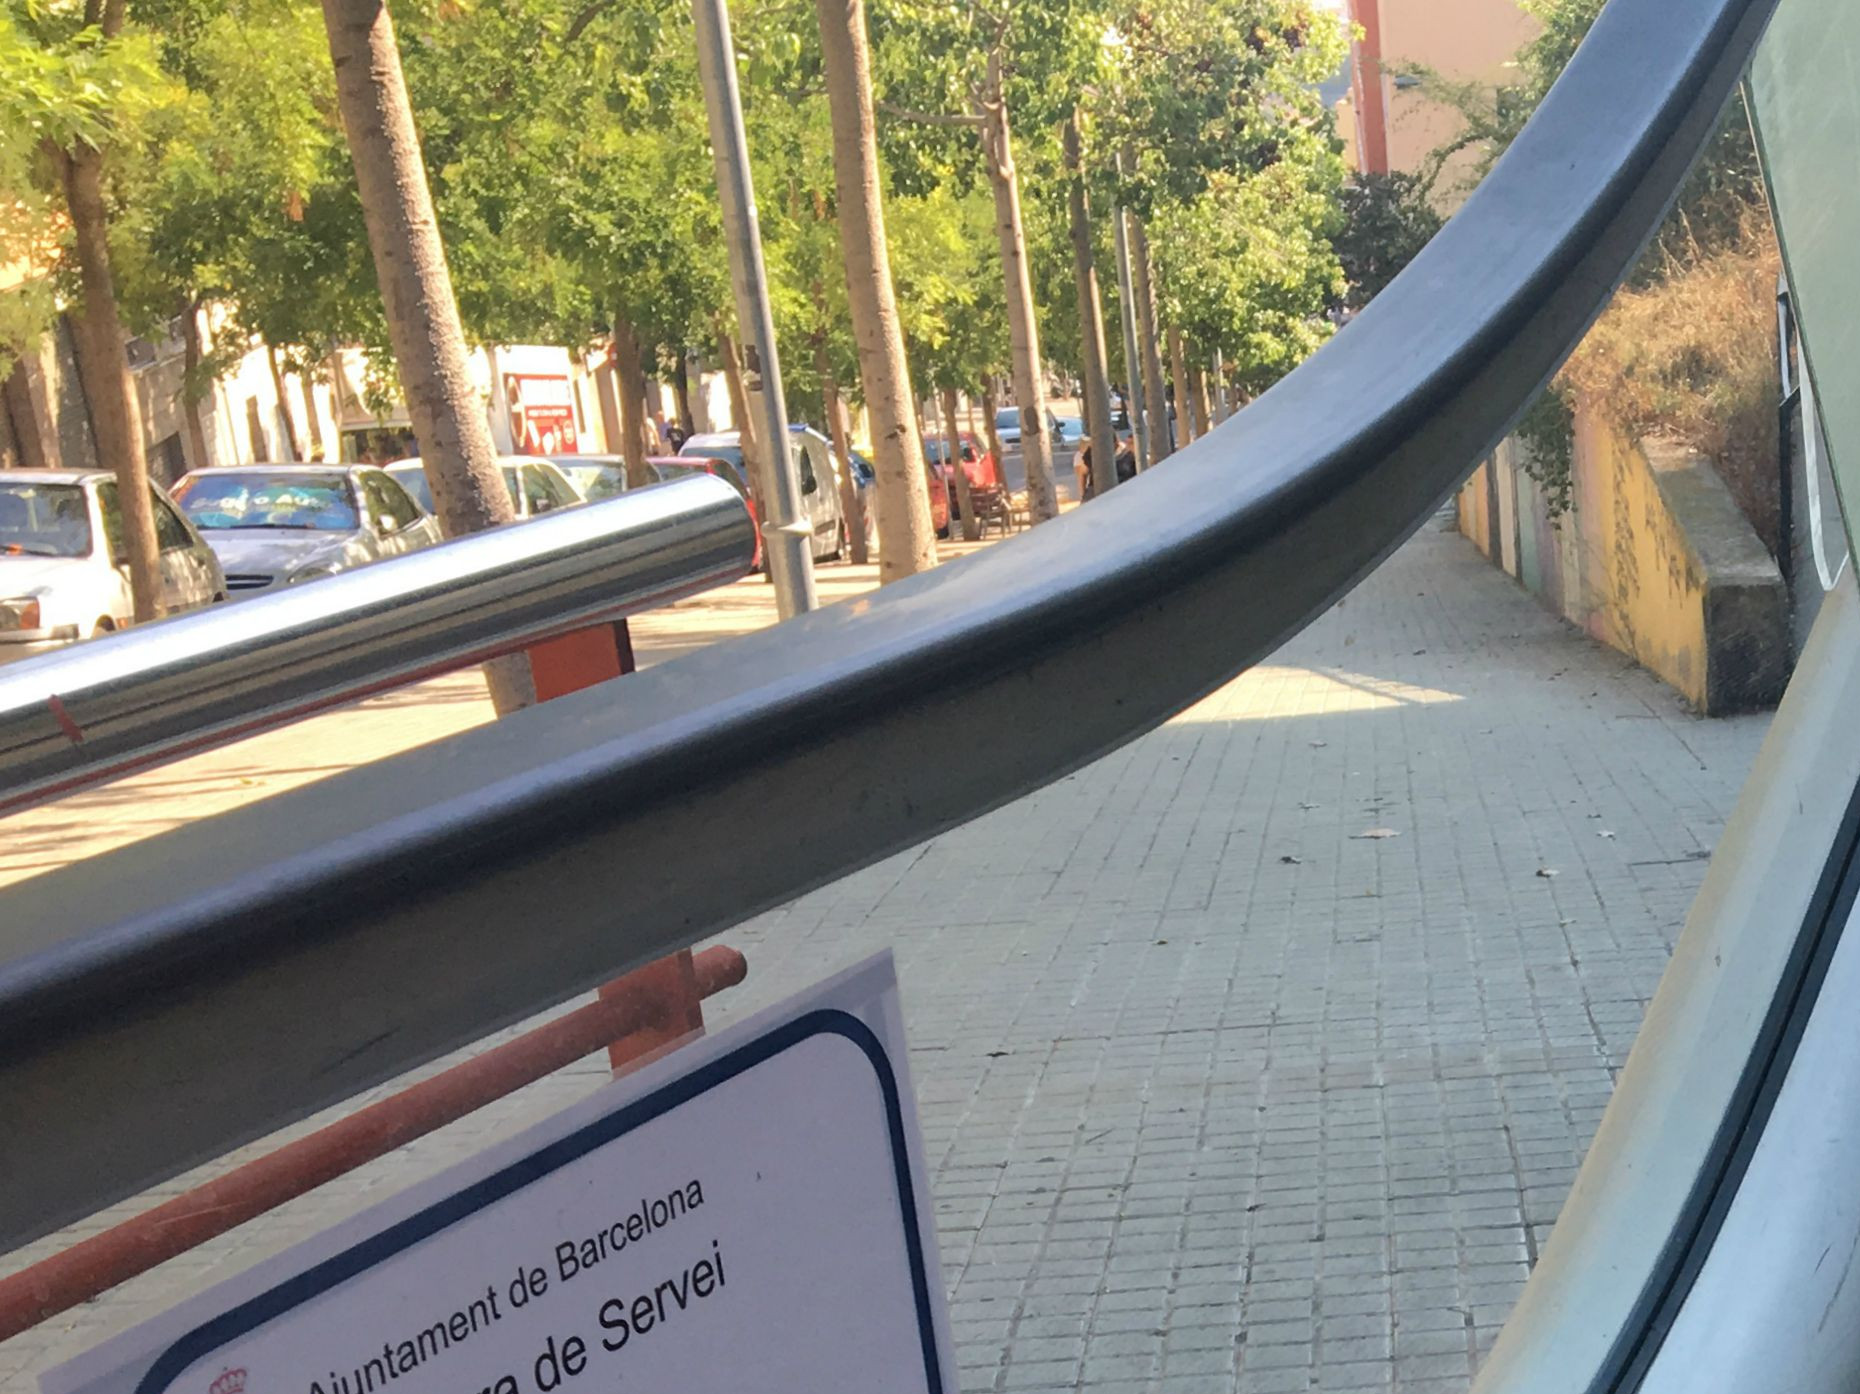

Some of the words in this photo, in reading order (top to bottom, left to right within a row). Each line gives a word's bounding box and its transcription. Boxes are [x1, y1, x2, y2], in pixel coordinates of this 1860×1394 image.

[509, 1267, 547, 1307] de
[555, 1180, 704, 1281] Barcelona
[534, 1335, 587, 1392] de
[599, 1240, 726, 1351] Servei
